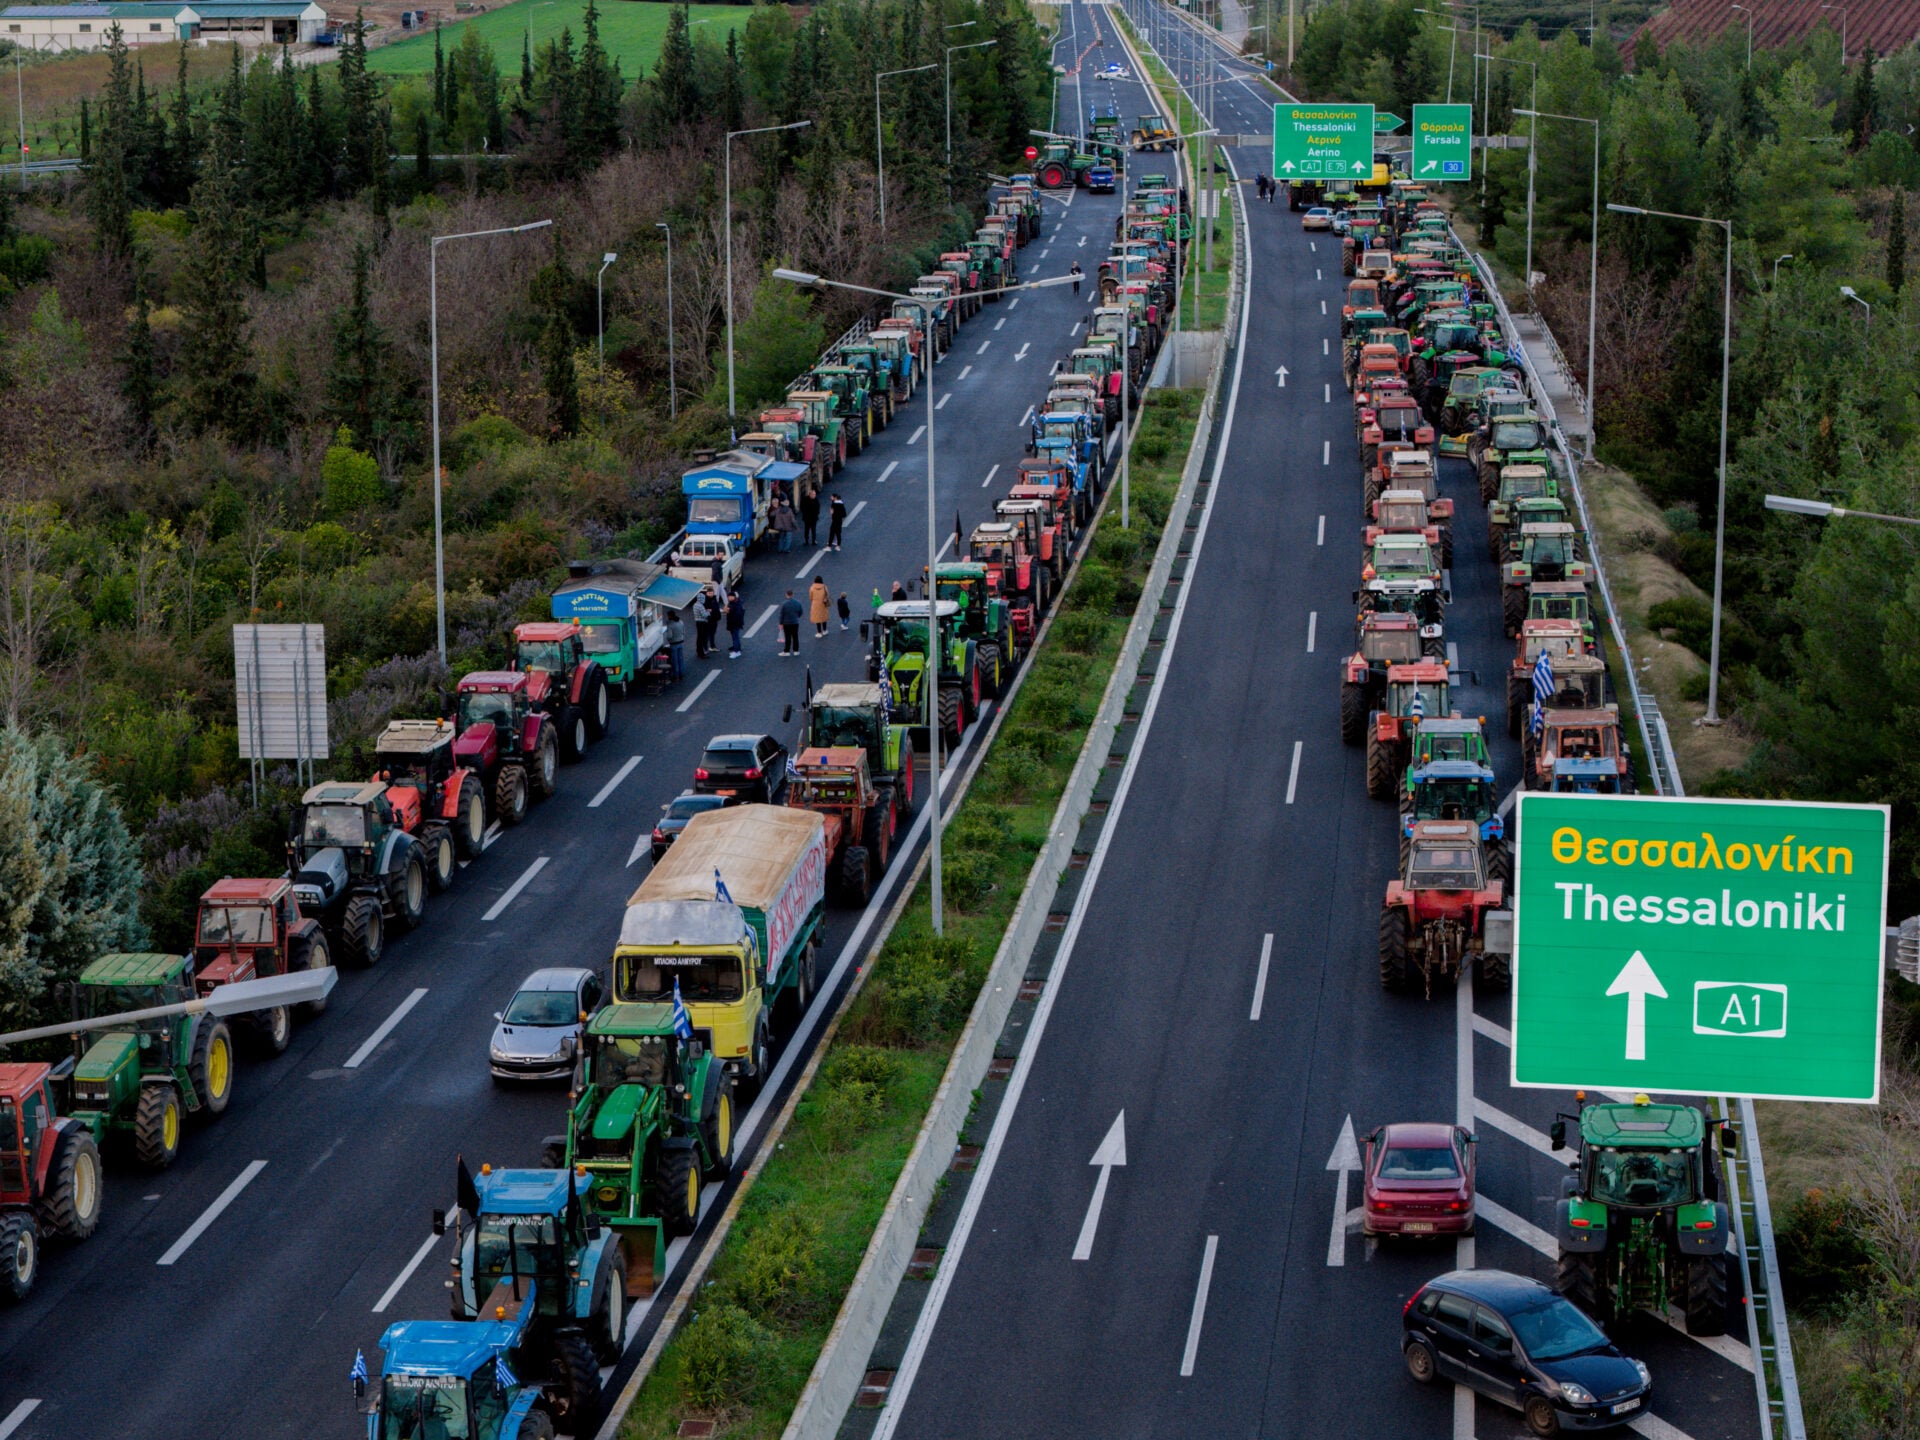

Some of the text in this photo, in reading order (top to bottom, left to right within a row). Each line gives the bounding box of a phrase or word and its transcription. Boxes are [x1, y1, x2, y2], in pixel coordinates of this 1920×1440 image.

[1292, 110, 1357, 119] Θεσσαλονίκη
[1293, 122, 1356, 132] Thessaloniki
[1420, 122, 1465, 133] Φάρσαλα
[1307, 134, 1341, 145] Αερινό
[1424, 135, 1461, 145] Farsala
[1307, 148, 1341, 157] Aerino
[1306, 162, 1317, 170] A1
[1448, 163, 1459, 171] 30
[1552, 827, 1853, 875] Θεσσαλονίκη
[1554, 882, 1846, 931] Thessaloniki
[1720, 993, 1761, 1026] A1
